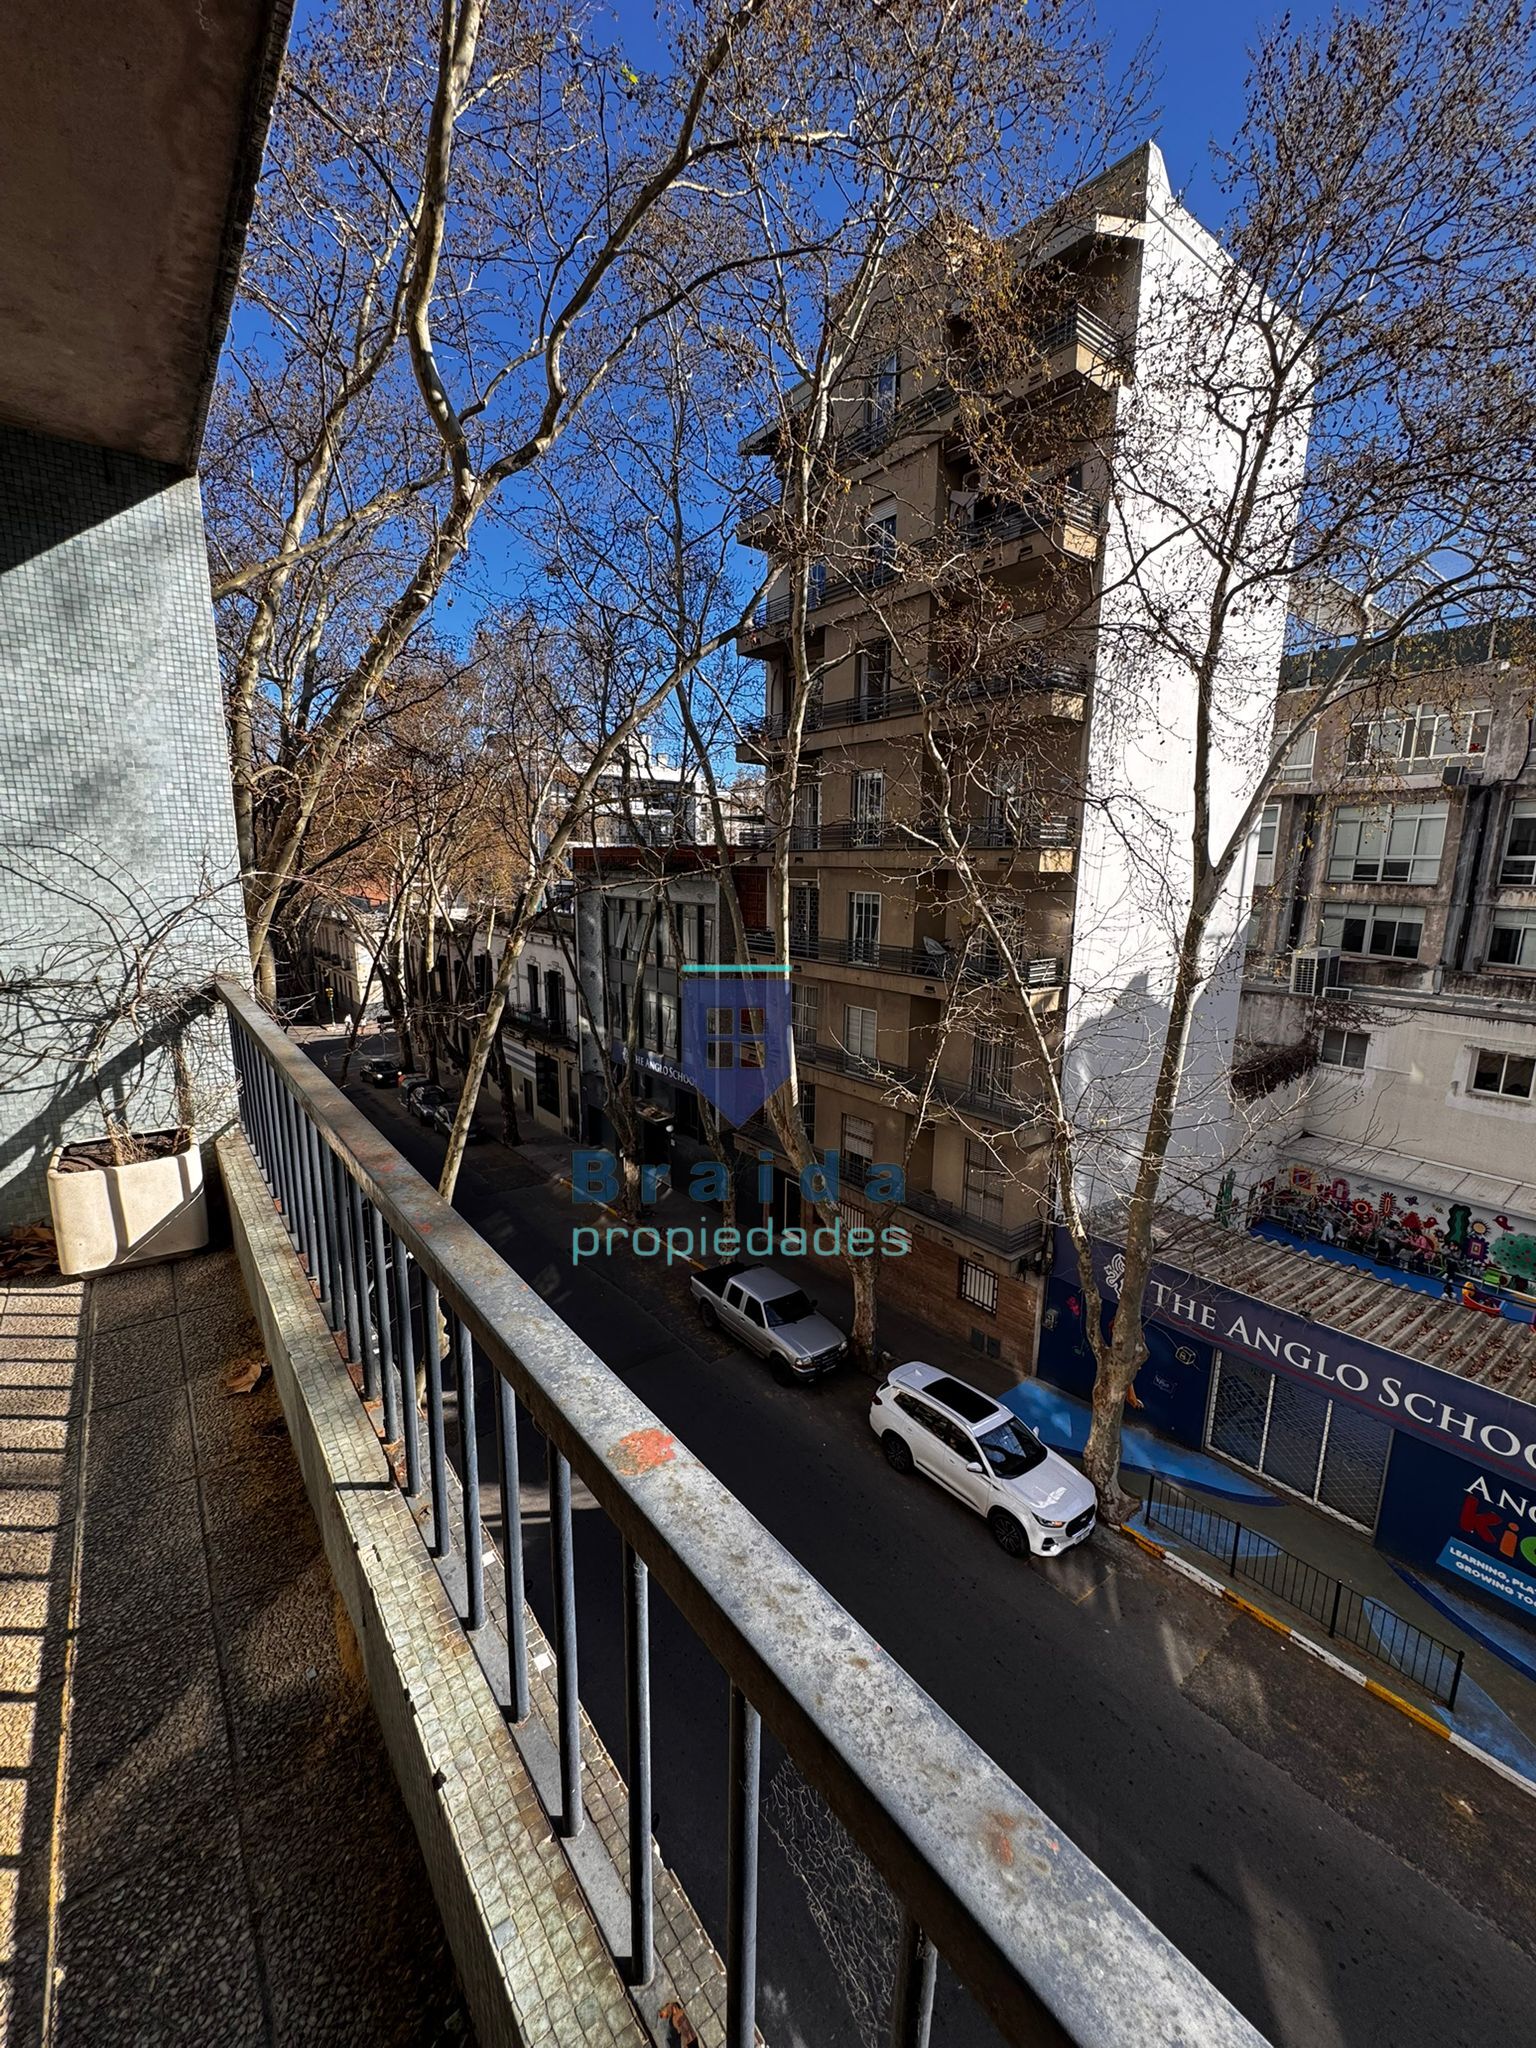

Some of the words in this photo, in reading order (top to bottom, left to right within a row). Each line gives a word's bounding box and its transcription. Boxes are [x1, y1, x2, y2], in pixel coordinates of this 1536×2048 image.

[645, 1060, 669, 1076] ANGLO
[1150, 1280, 1217, 1331] THE
[1224, 1315, 1369, 1392] ANGLO
[1449, 1547, 1510, 1583] LEARNING,
[1511, 1577, 1536, 1595] PLA
[1455, 1561, 1514, 1595] GROWING
[1517, 1591, 1536, 1608] TO
